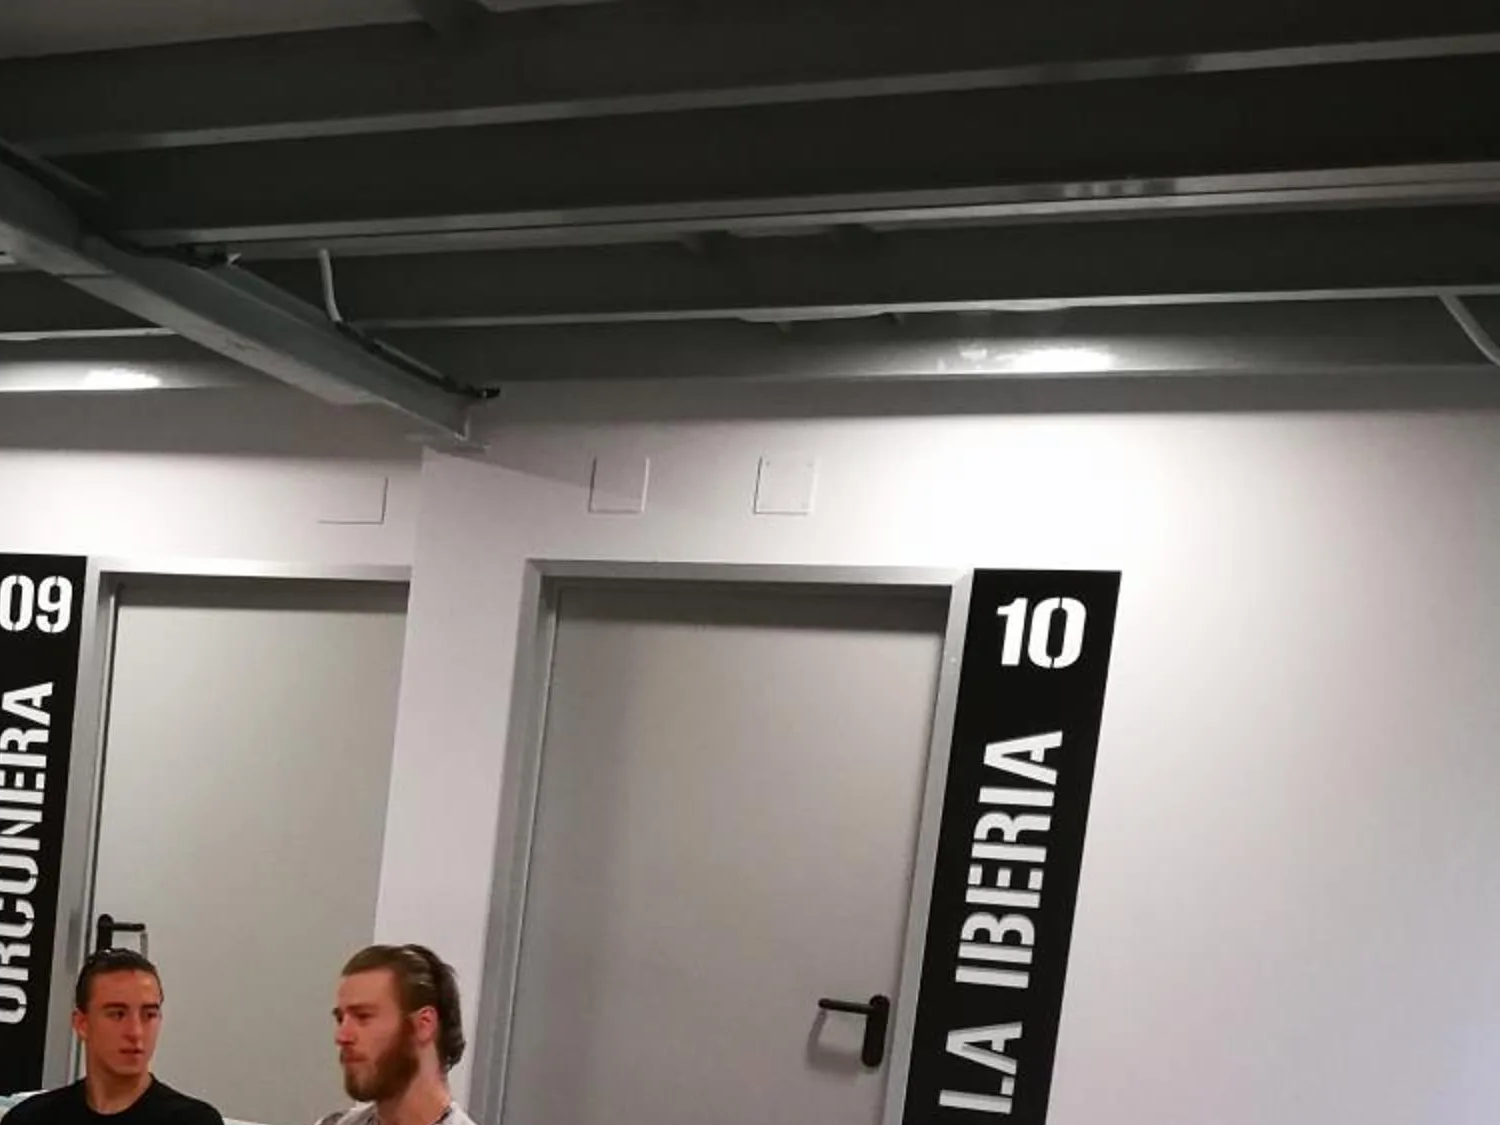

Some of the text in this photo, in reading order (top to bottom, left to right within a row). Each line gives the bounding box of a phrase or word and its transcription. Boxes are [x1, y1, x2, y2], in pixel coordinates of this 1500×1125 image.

[996, 597, 1087, 669] 10
[939, 730, 1063, 1114] LA IBERIA
